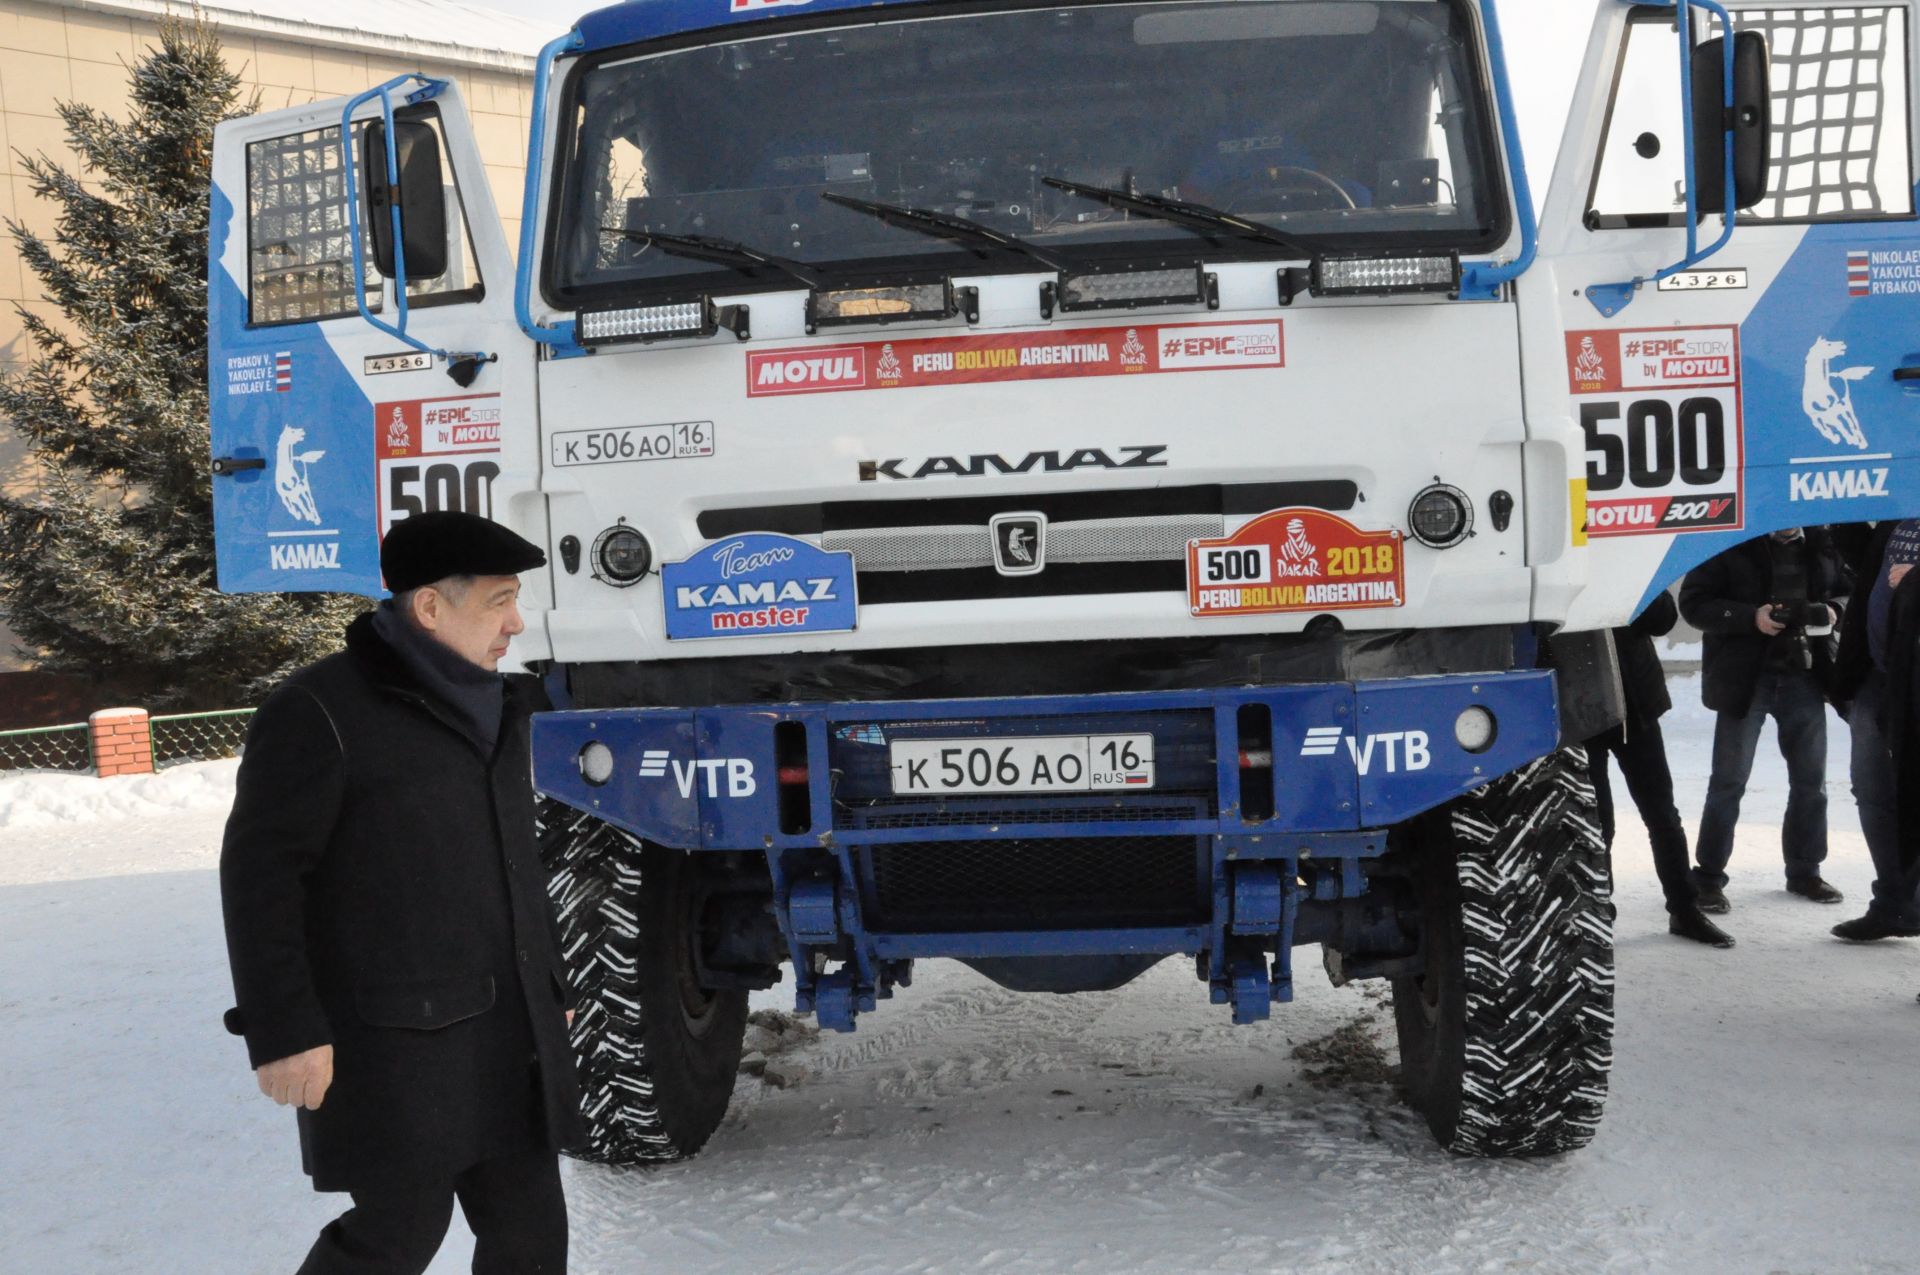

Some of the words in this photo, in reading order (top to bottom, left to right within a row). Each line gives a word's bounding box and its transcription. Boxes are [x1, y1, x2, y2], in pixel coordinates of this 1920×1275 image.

[1872, 250, 1920, 264] NIKOLAE
[1669, 274, 1737, 287] 4326
[228, 354, 262, 369] RYBAKOV
[372, 357, 423, 371] 4326
[912, 352, 953, 373] PERU
[955, 348, 1018, 370] BOLIVIA
[1020, 343, 1109, 366] ARGENTINA
[1644, 363, 1656, 378] by
[1665, 359, 1727, 376] MOTUL
[228, 368, 265, 382] YAKOVLEV
[758, 356, 858, 385] MOTUL
[228, 381, 264, 395] NIKOLAEV
[438, 430, 448, 443] by
[679, 424, 704, 445] 16
[1580, 396, 1725, 491] 500
[679, 446, 698, 455] RUS
[858, 445, 1168, 482] KAMAZ
[1790, 468, 1889, 501] KAMAZ
[1664, 499, 1732, 521] 300V
[270, 543, 341, 570] KAMAZ
[713, 541, 793, 579] Team
[1207, 549, 1261, 581] 500
[1277, 558, 1321, 578] DAKAR
[1327, 544, 1394, 576] 2018
[677, 578, 836, 609] KAMAZ
[712, 606, 808, 629] master
[1100, 740, 1140, 771] 16
[1345, 730, 1431, 776] VTB
[671, 758, 757, 798] VTB
[1093, 772, 1123, 784] RUS
